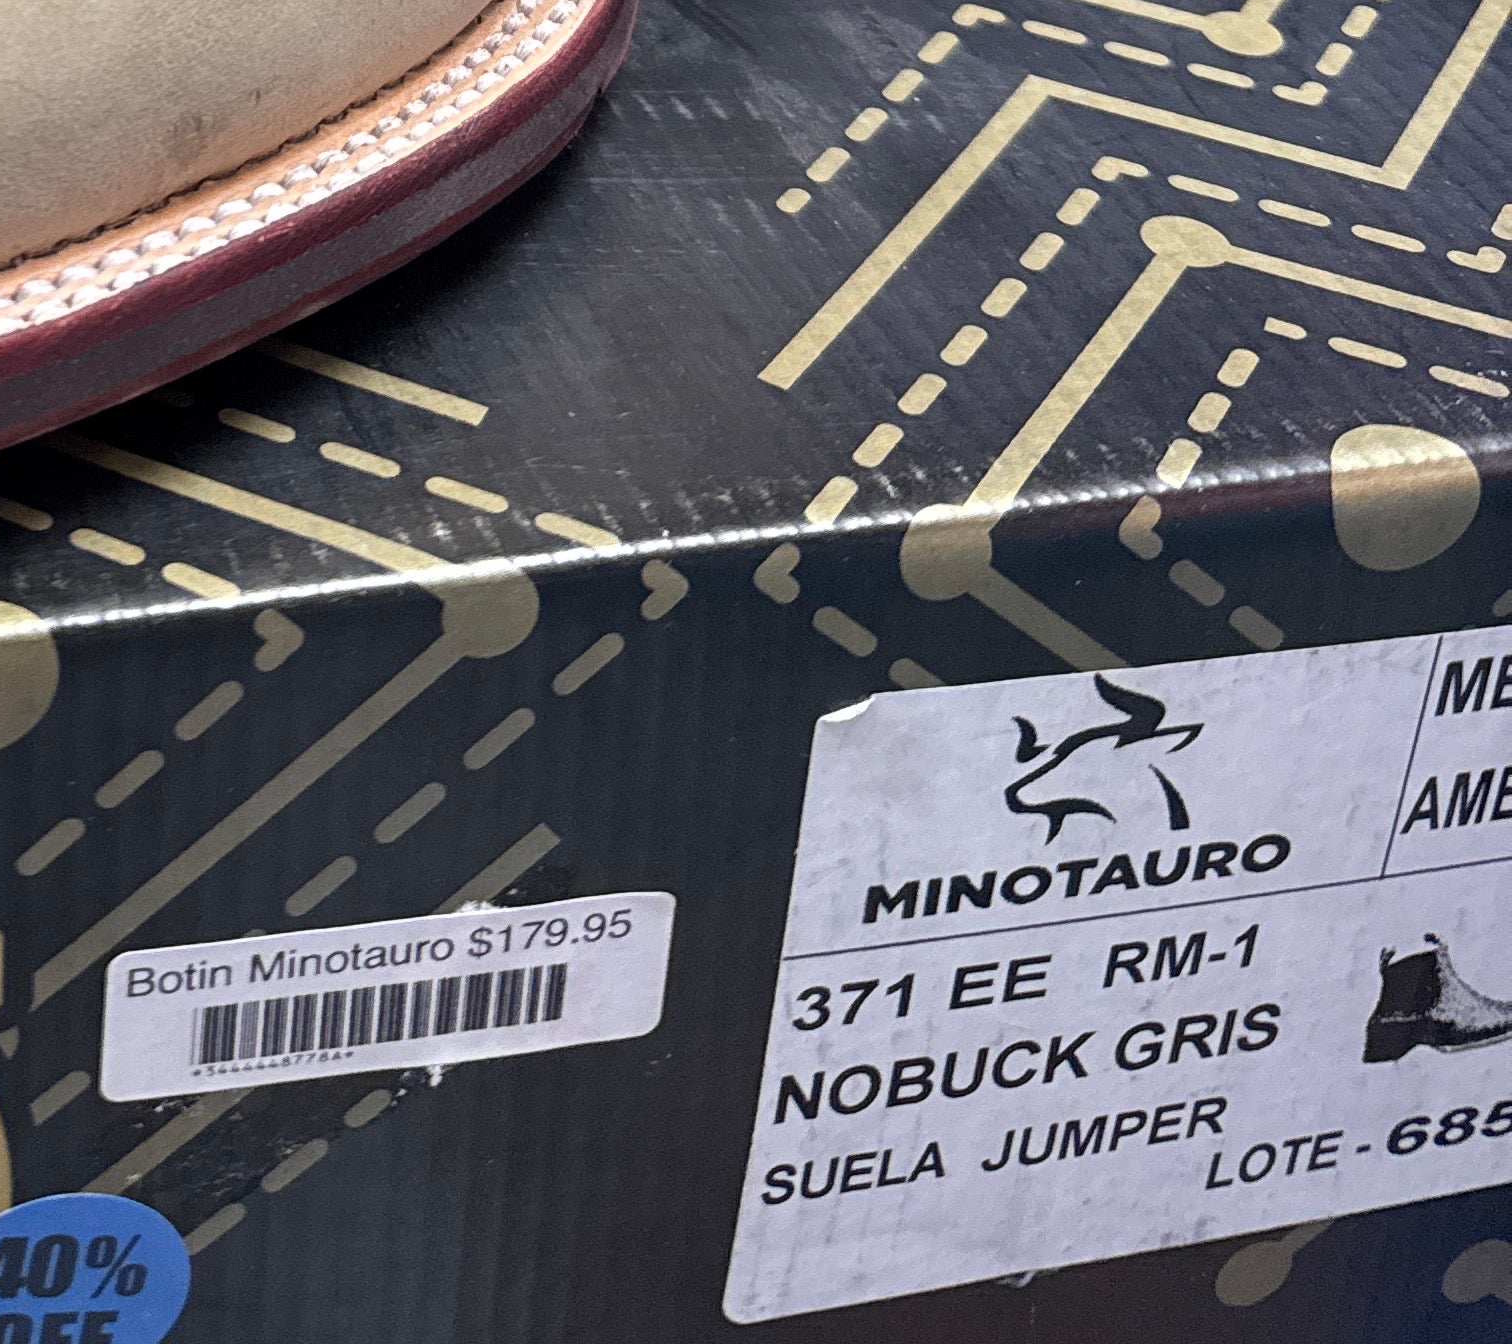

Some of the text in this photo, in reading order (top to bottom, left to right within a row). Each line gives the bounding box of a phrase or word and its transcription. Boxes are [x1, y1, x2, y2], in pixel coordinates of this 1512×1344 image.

[861, 833, 1292, 925] MINOTAURO
[126, 908, 634, 999] Botin Minotauro $179.95
[791, 923, 1261, 1032] 371 EE RM-1
[773, 1002, 1282, 1125] NOBUCK GRIS
[760, 1096, 1229, 1207] SUELA JUMPER
[1204, 1129, 1344, 1190] LOTE
